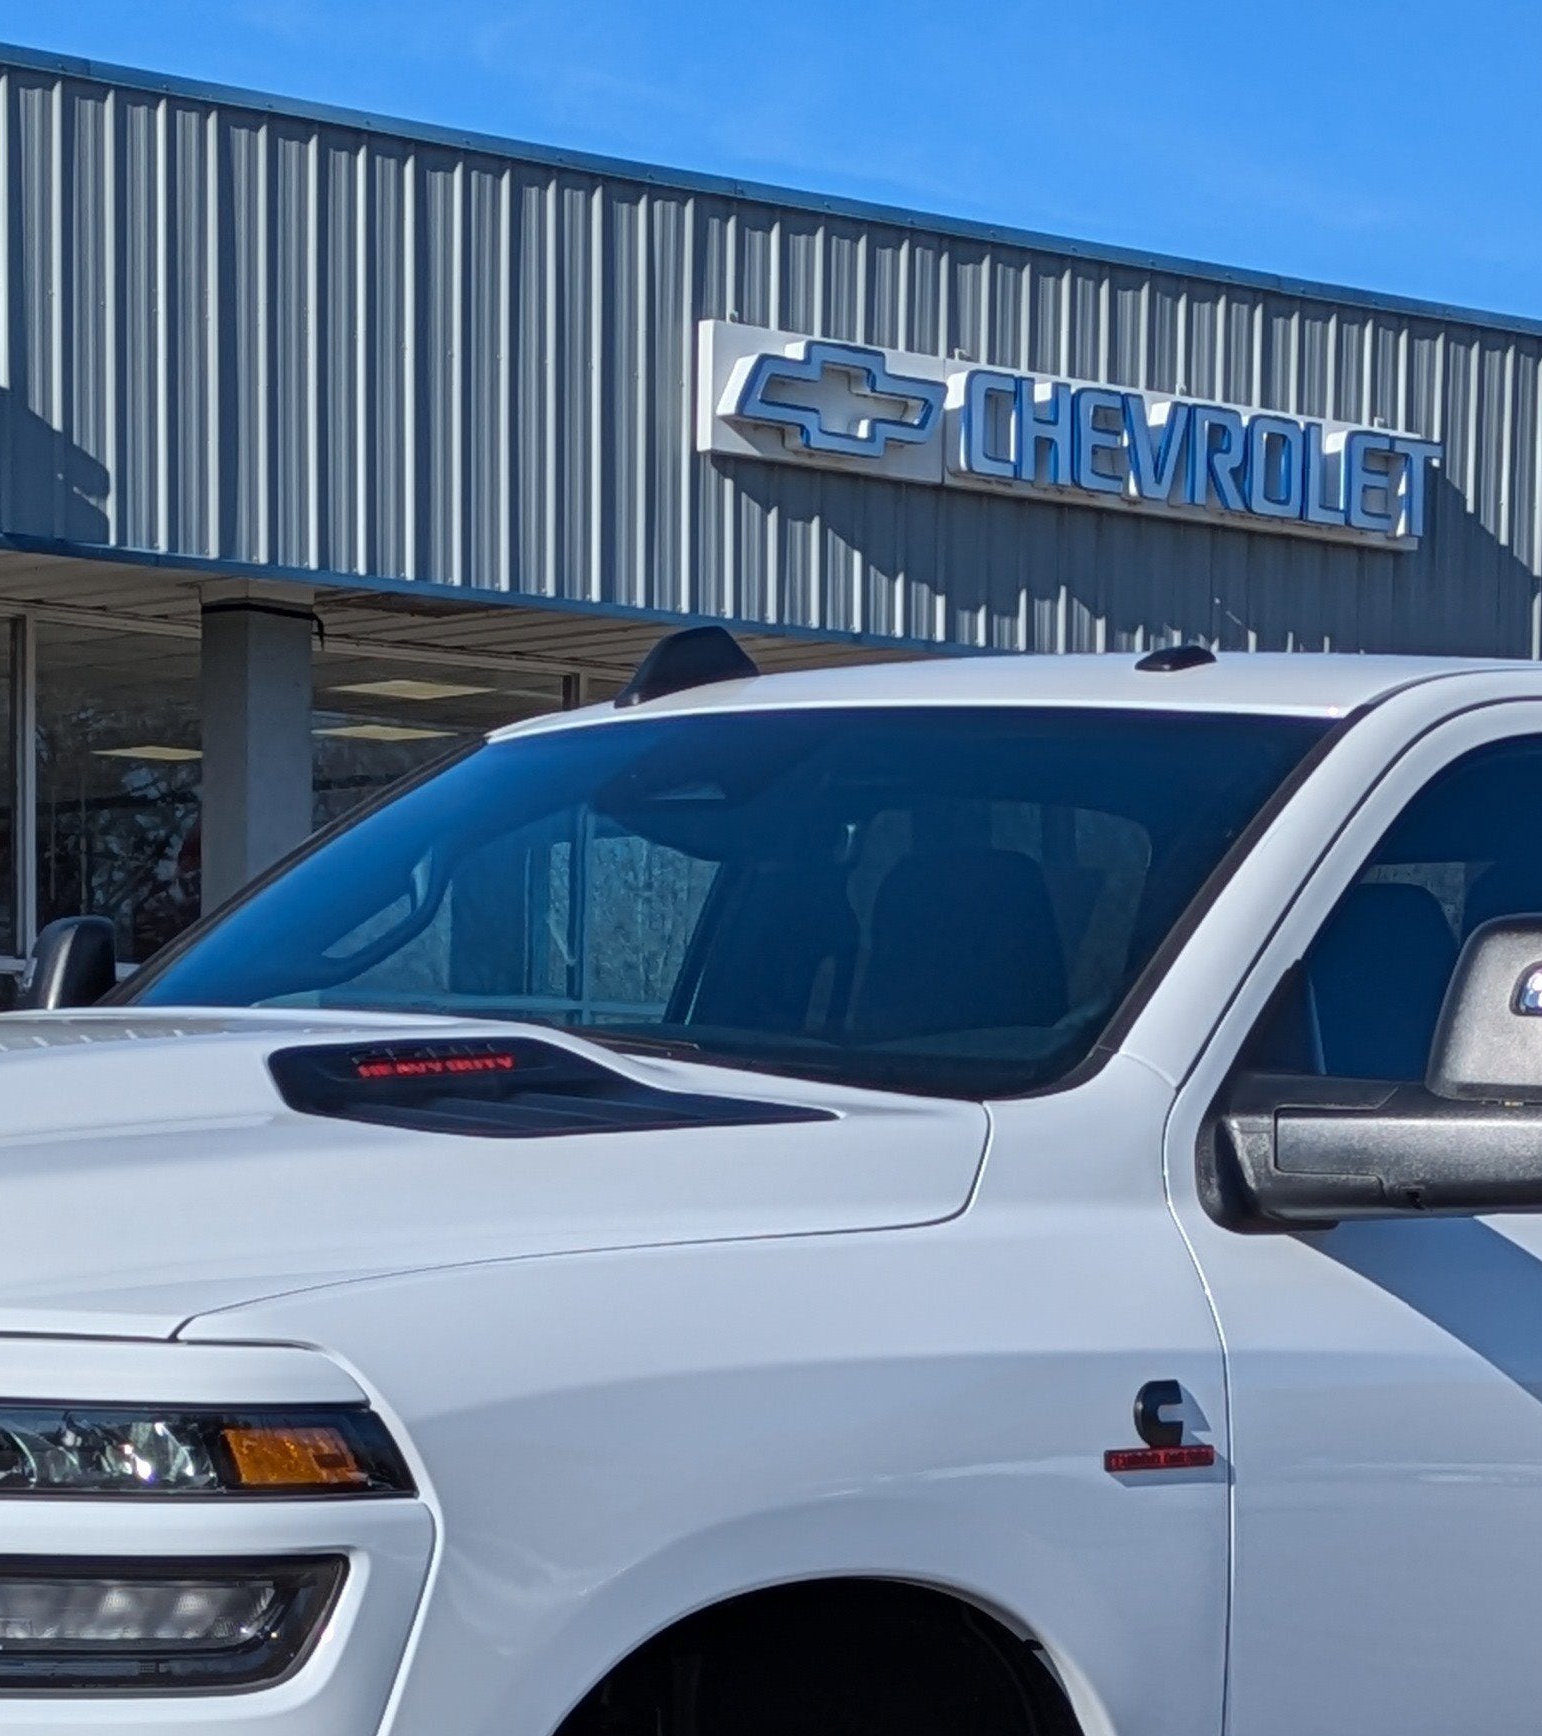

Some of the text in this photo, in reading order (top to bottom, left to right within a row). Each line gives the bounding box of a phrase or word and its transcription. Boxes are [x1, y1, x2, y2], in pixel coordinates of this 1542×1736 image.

[947, 368, 1442, 537] CHEVROLET
[358, 1055, 513, 1077] HEAVY DUTY
